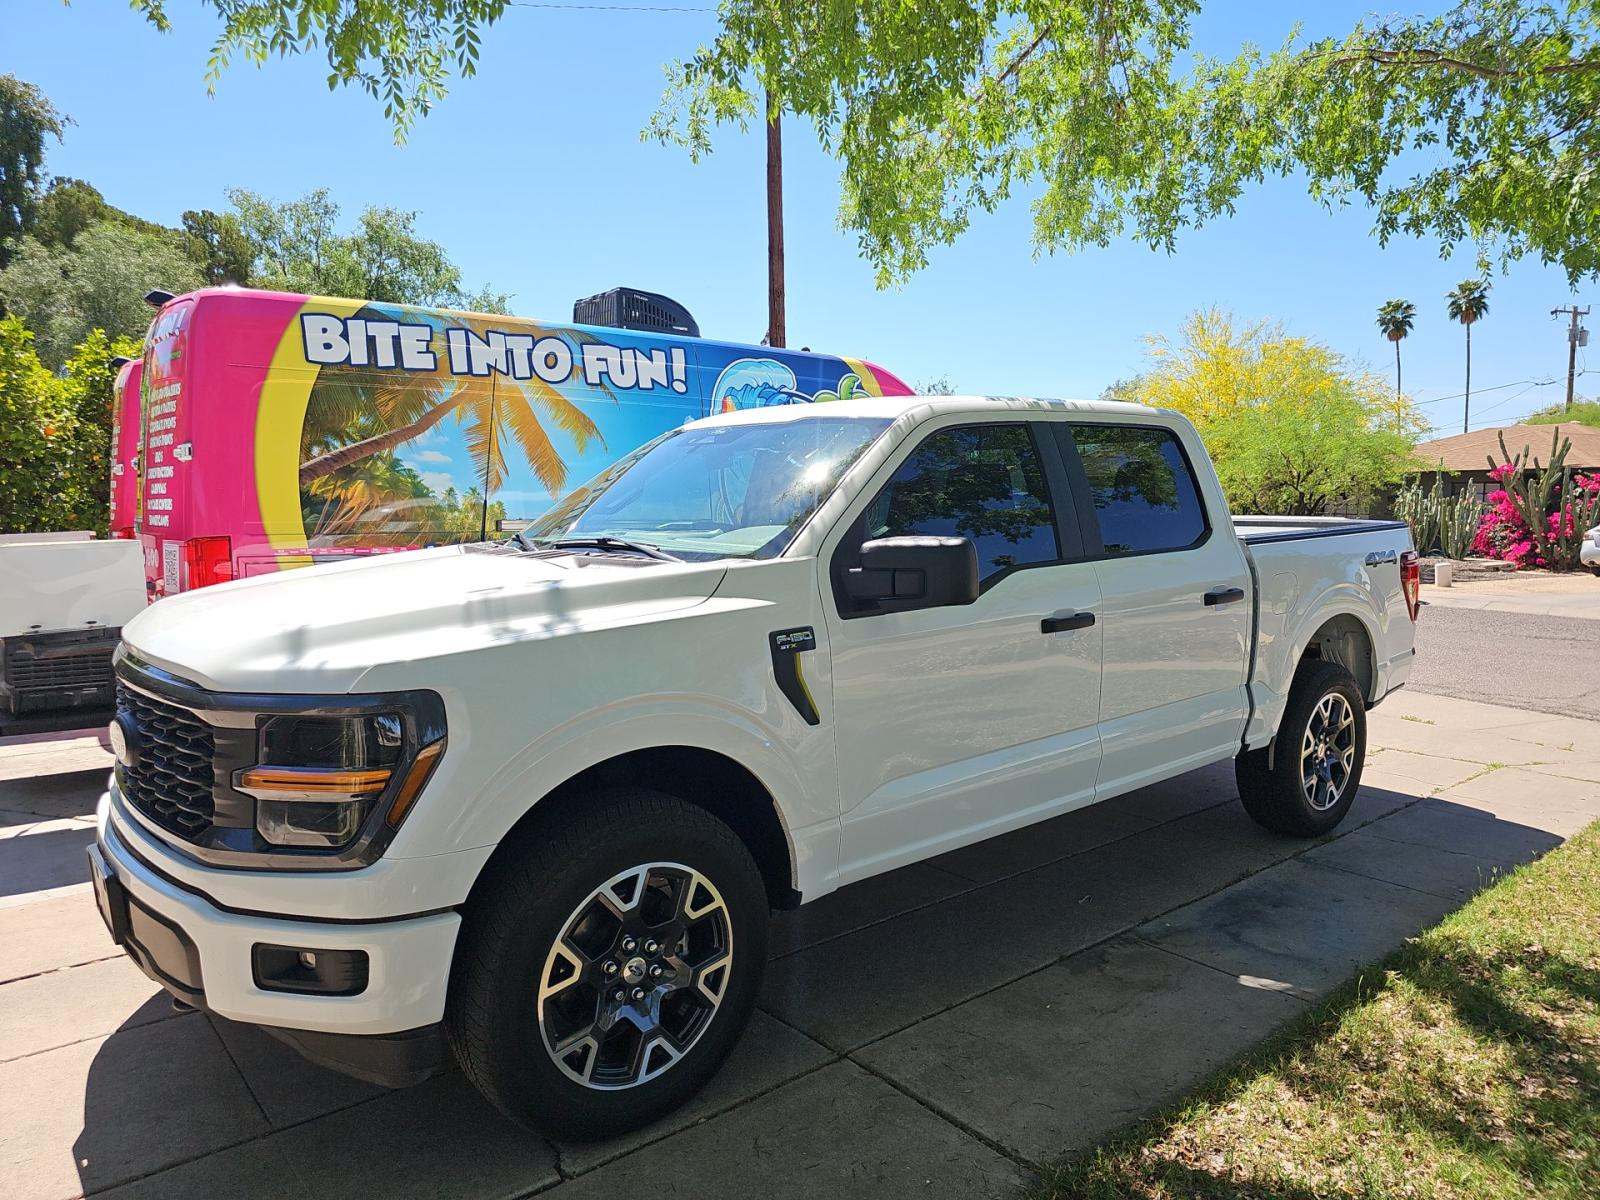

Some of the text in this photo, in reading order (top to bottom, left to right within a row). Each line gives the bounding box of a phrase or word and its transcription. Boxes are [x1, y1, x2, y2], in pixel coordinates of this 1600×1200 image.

[302, 314, 688, 393] BITE INTO FUN!
[776, 631, 812, 644] F-150
